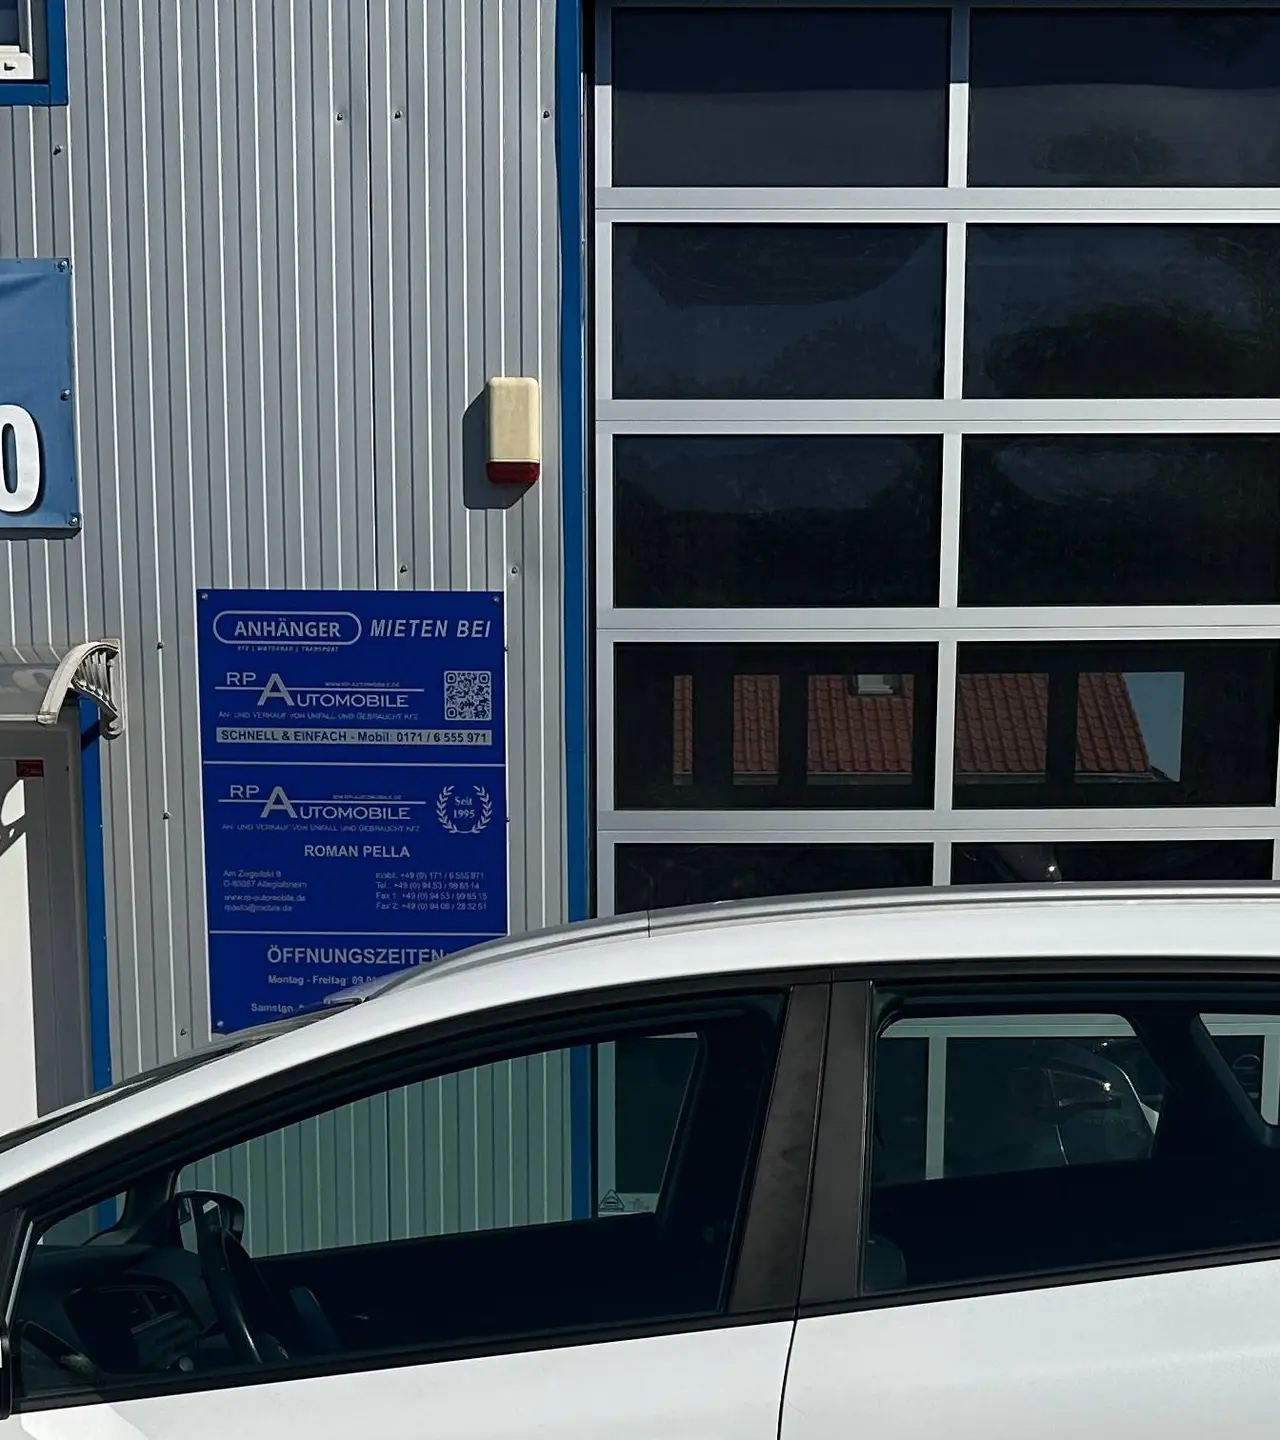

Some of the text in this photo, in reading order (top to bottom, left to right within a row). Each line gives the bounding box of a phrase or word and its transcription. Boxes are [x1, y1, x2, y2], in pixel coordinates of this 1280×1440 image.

[234, 617, 491, 638] ANHÄNGER MIETEN BEI
[226, 671, 257, 686] RP
[221, 729, 278, 741] SCHNELL
[281, 730, 291, 741] &
[294, 731, 347, 742] EINFACH
[358, 732, 393, 743] Mobil:
[396, 732, 422, 742] 0171
[433, 733, 441, 743] 6
[444, 733, 464, 743] 555
[467, 733, 487, 743] 971
[230, 784, 260, 799] RP
[454, 796, 473, 806] Seit
[453, 809, 475, 819] 1995
[304, 844, 411, 858] ROMAN PELLA
[268, 975, 304, 986] Montag
